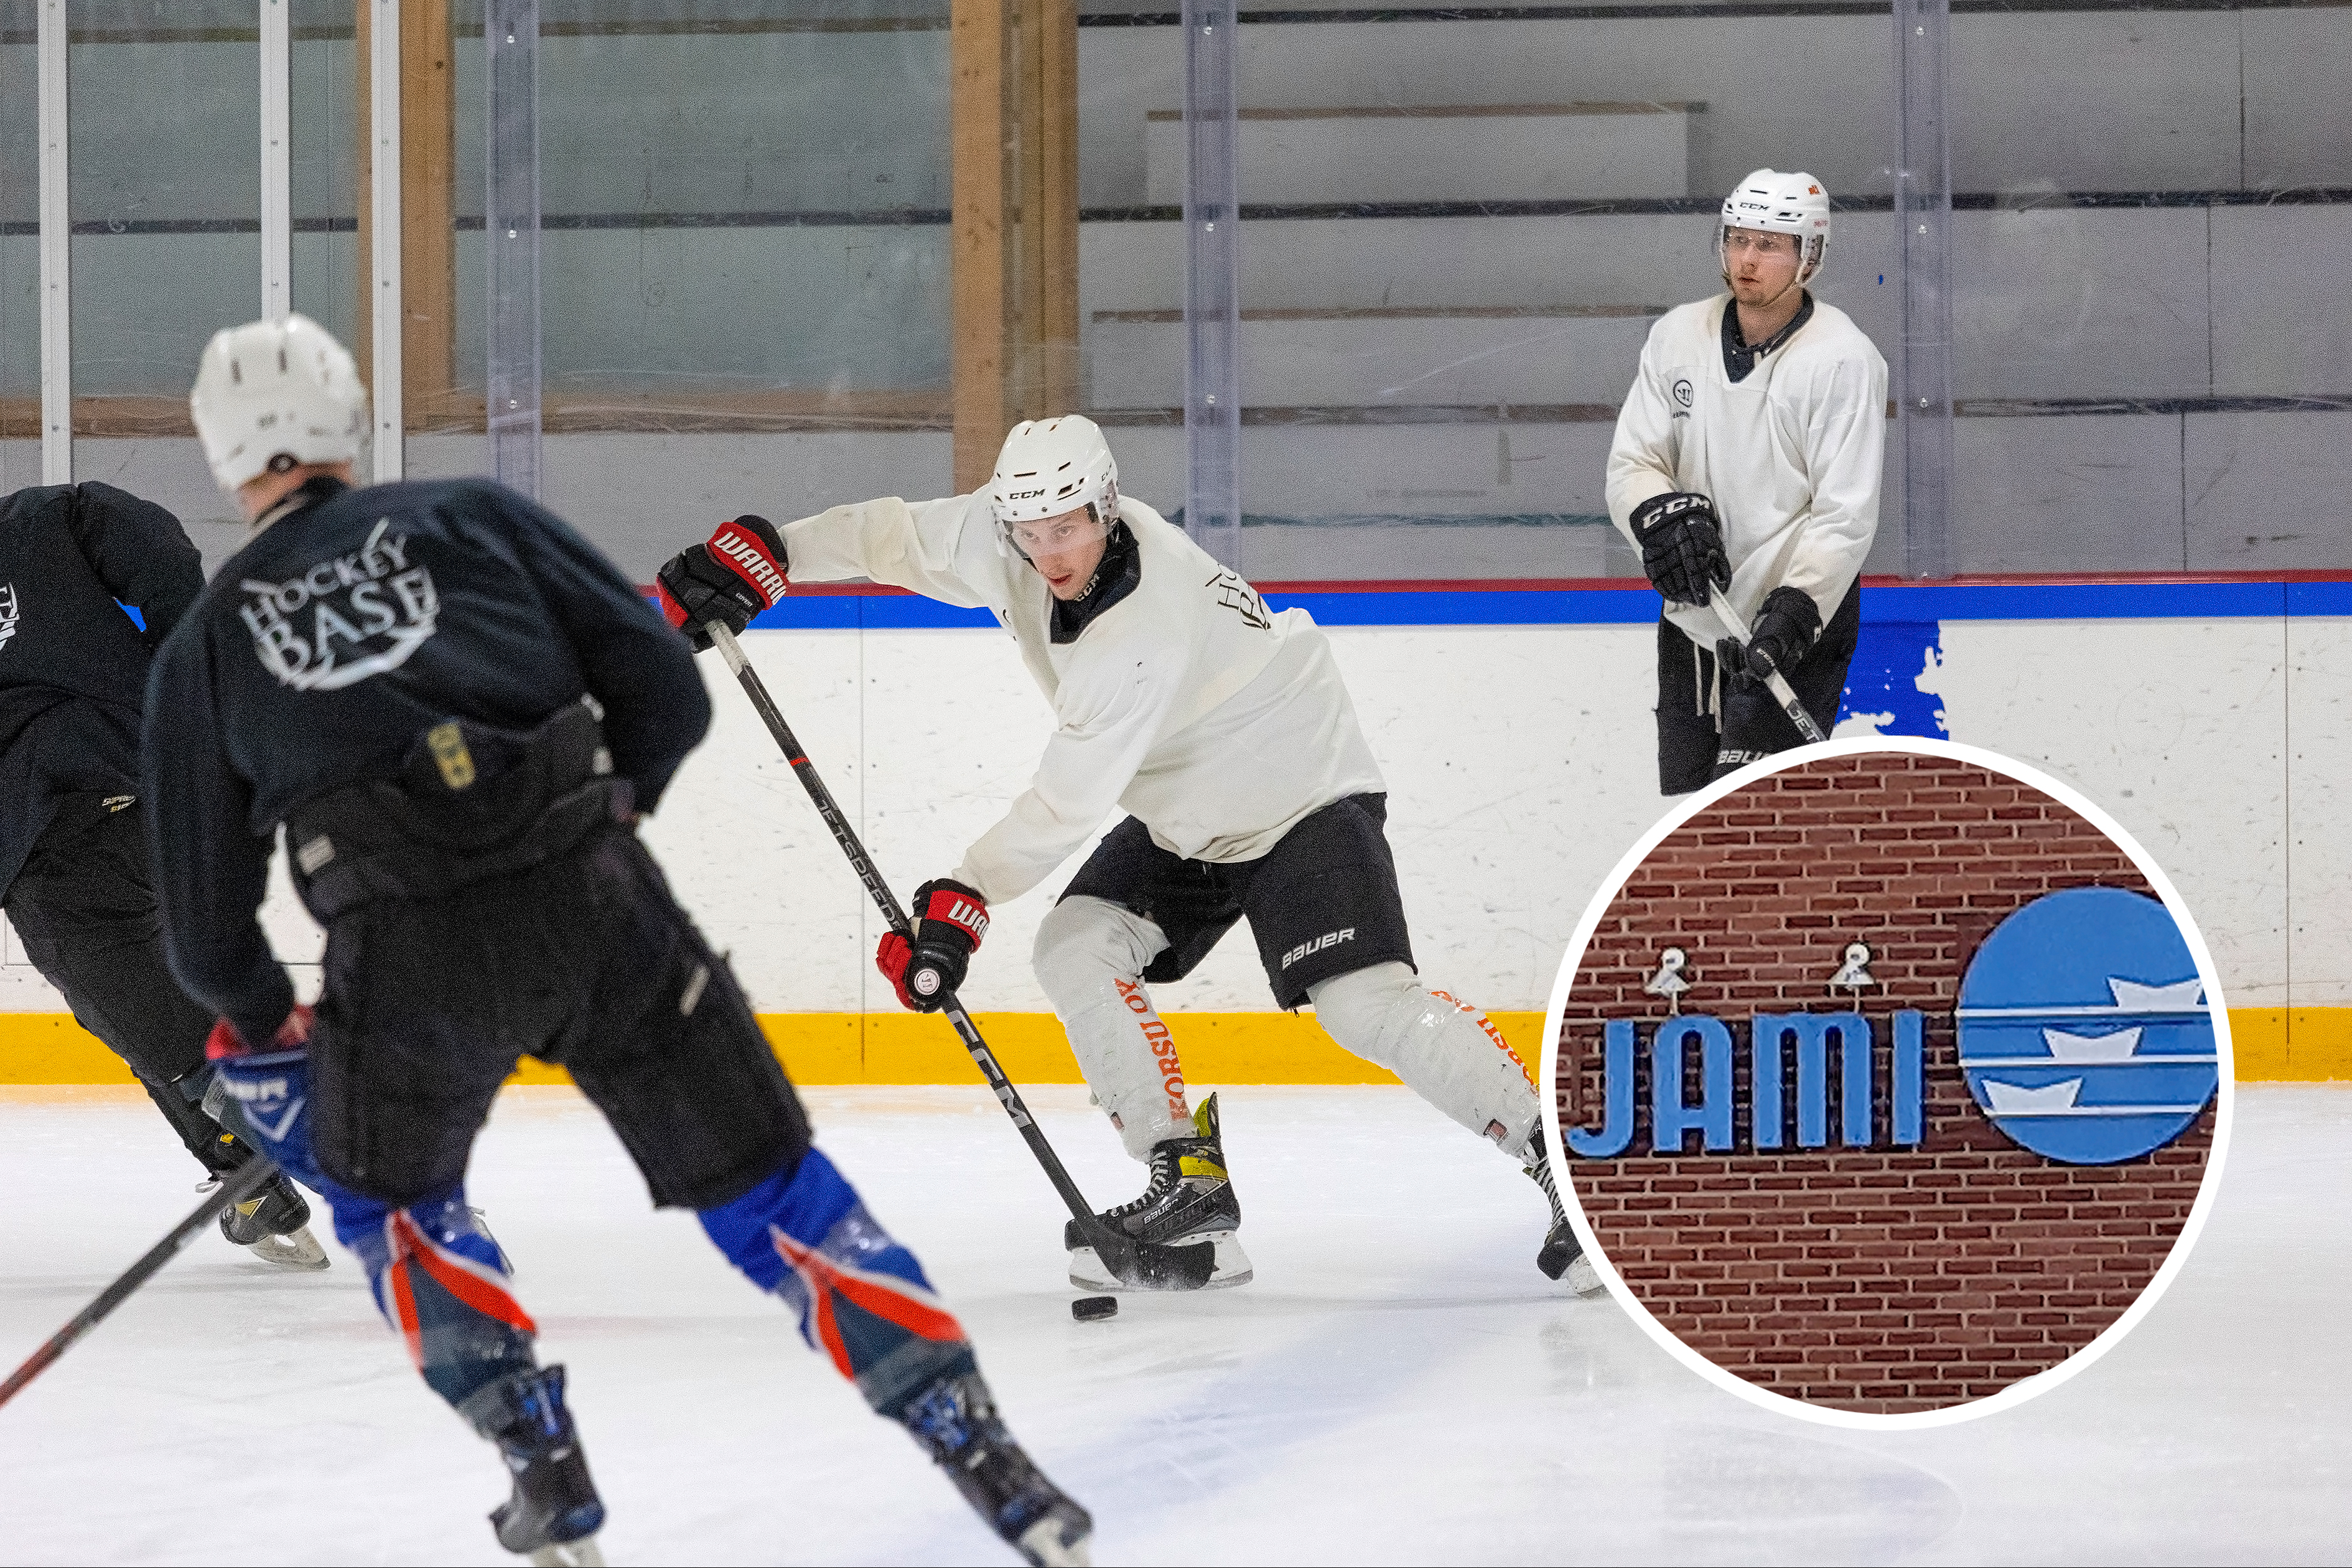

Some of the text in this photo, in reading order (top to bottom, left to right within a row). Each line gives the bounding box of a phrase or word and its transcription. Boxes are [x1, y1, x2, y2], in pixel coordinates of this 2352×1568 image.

[1740, 202, 1771, 212] CCM
[1009, 488, 1046, 500] CCM
[1643, 497, 1710, 530] CCM
[240, 516, 408, 625] HOCKEY
[1114, 978, 1148, 1014] OY
[946, 1009, 1032, 1129] CCM
[1565, 1009, 1924, 1158] JAMI
